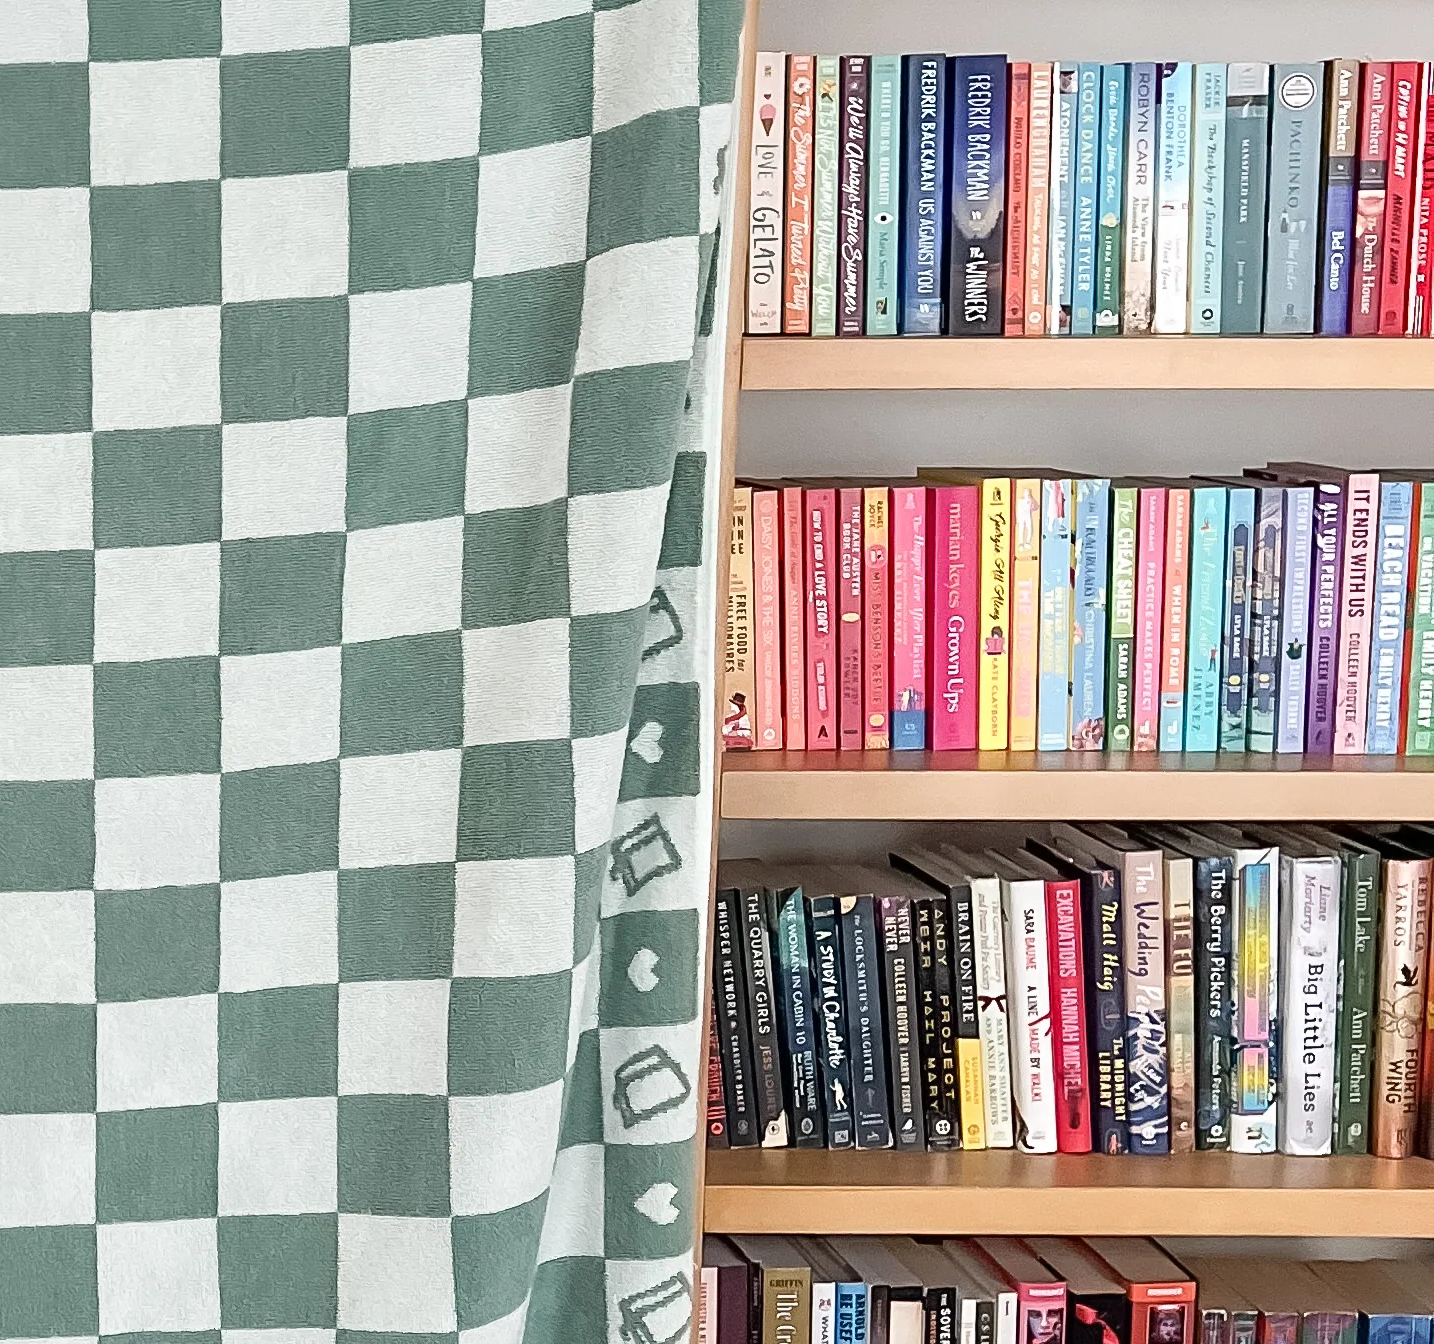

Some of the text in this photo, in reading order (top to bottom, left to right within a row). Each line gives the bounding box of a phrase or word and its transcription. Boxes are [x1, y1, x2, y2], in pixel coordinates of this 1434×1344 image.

[920, 61, 936, 191] FREDRIK BACKMAN
[967, 75, 991, 200] FREDRIK BACKMAN
[1136, 72, 1150, 185] ROBYN CARR
[1165, 92, 1174, 181] BENTON FRANK
[1177, 105, 1186, 168] DOROTHEA
[1336, 70, 1352, 150] Ann Patchett
[1369, 73, 1385, 154] Ann Patchett
[756, 144, 777, 180] LOVE
[1079, 72, 1095, 291] CLOCK DANCE ANNE TYLER
[1288, 120, 1303, 208] PACHINKO
[786, 96, 811, 311] The Summer I Turned Pretty
[842, 97, 863, 314] We'll Always Have Summer
[752, 207, 779, 285] GELATO
[918, 198, 935, 293] US AGAINST YOU
[1329, 231, 1344, 290] Bel Canto
[843, 523, 851, 578] BOOK CLUB
[852, 506, 860, 525] THE
[1349, 489, 1370, 617] IT ENDS WITH US
[851, 557, 859, 595] AUSTEN
[943, 504, 965, 608] marian keyes
[1116, 500, 1132, 625] The CHEAT SHEET
[1319, 503, 1337, 628] ALL YOUR PERFECTS
[1379, 524, 1404, 641] BEACH READ
[737, 594, 746, 622] FREE
[737, 626, 747, 654] FOOD
[1142, 562, 1155, 711] PRACTICE MAKES PERFECT
[1168, 585, 1181, 685] WHEN IN ROME
[943, 616, 964, 713] Grown Ups
[1116, 644, 1128, 719] SARAH ADAMS
[1316, 636, 1329, 722] COLLEEN HOOVER
[1346, 633, 1360, 722] COLLEEN HOOVER
[1376, 648, 1394, 727] EMILY HENRY
[787, 899, 797, 922] THE
[886, 917, 898, 951] NEVER
[898, 908, 909, 943] NEVER
[1024, 909, 1036, 971] SARA BAUME
[1056, 889, 1076, 977] EXCAVATIONS
[1303, 875, 1316, 933] Moriarty
[1319, 885, 1330, 921] Liane
[1355, 877, 1372, 952] Tom Lake
[1394, 884, 1408, 947] YARROS
[1415, 877, 1427, 953] REBECCA
[718, 901, 737, 1017] WHISPER NETWORK
[747, 894, 770, 1034] THE QUARRY GIRLS
[788, 924, 799, 972] WOMAN
[792, 976, 801, 988] IN
[957, 902, 974, 1022] BRAIN ON FIRE
[1097, 902, 1118, 991] Matt Haig
[1206, 869, 1225, 1018] The Berry Pickers
[793, 991, 804, 1027] CABIN
[795, 1031, 806, 1044] 10
[816, 931, 845, 1068] A STUDY IN Charlotte
[894, 958, 910, 1044] COLLEEN HOOVER
[919, 910, 939, 1111] WEIR HAIL MARY
[935, 910, 955, 1100] ANDY PROJECT
[1304, 964, 1324, 1112] Big Little Lies
[760, 1045, 773, 1070] JESS
[803, 1051, 817, 1111] RUTH WARE
[1099, 1052, 1111, 1107] LIBRARY
[1115, 1059, 1125, 1121] MIDNIGHT
[1350, 1008, 1366, 1103] Ann Patchett
[1386, 1060, 1403, 1104] WING
[1404, 1049, 1418, 1113] FOURTH
[776, 1293, 798, 1320] The
[820, 1316, 828, 1344] WHAT
[840, 1294, 852, 1308] BE
[854, 1294, 865, 1340] ARNOLD
